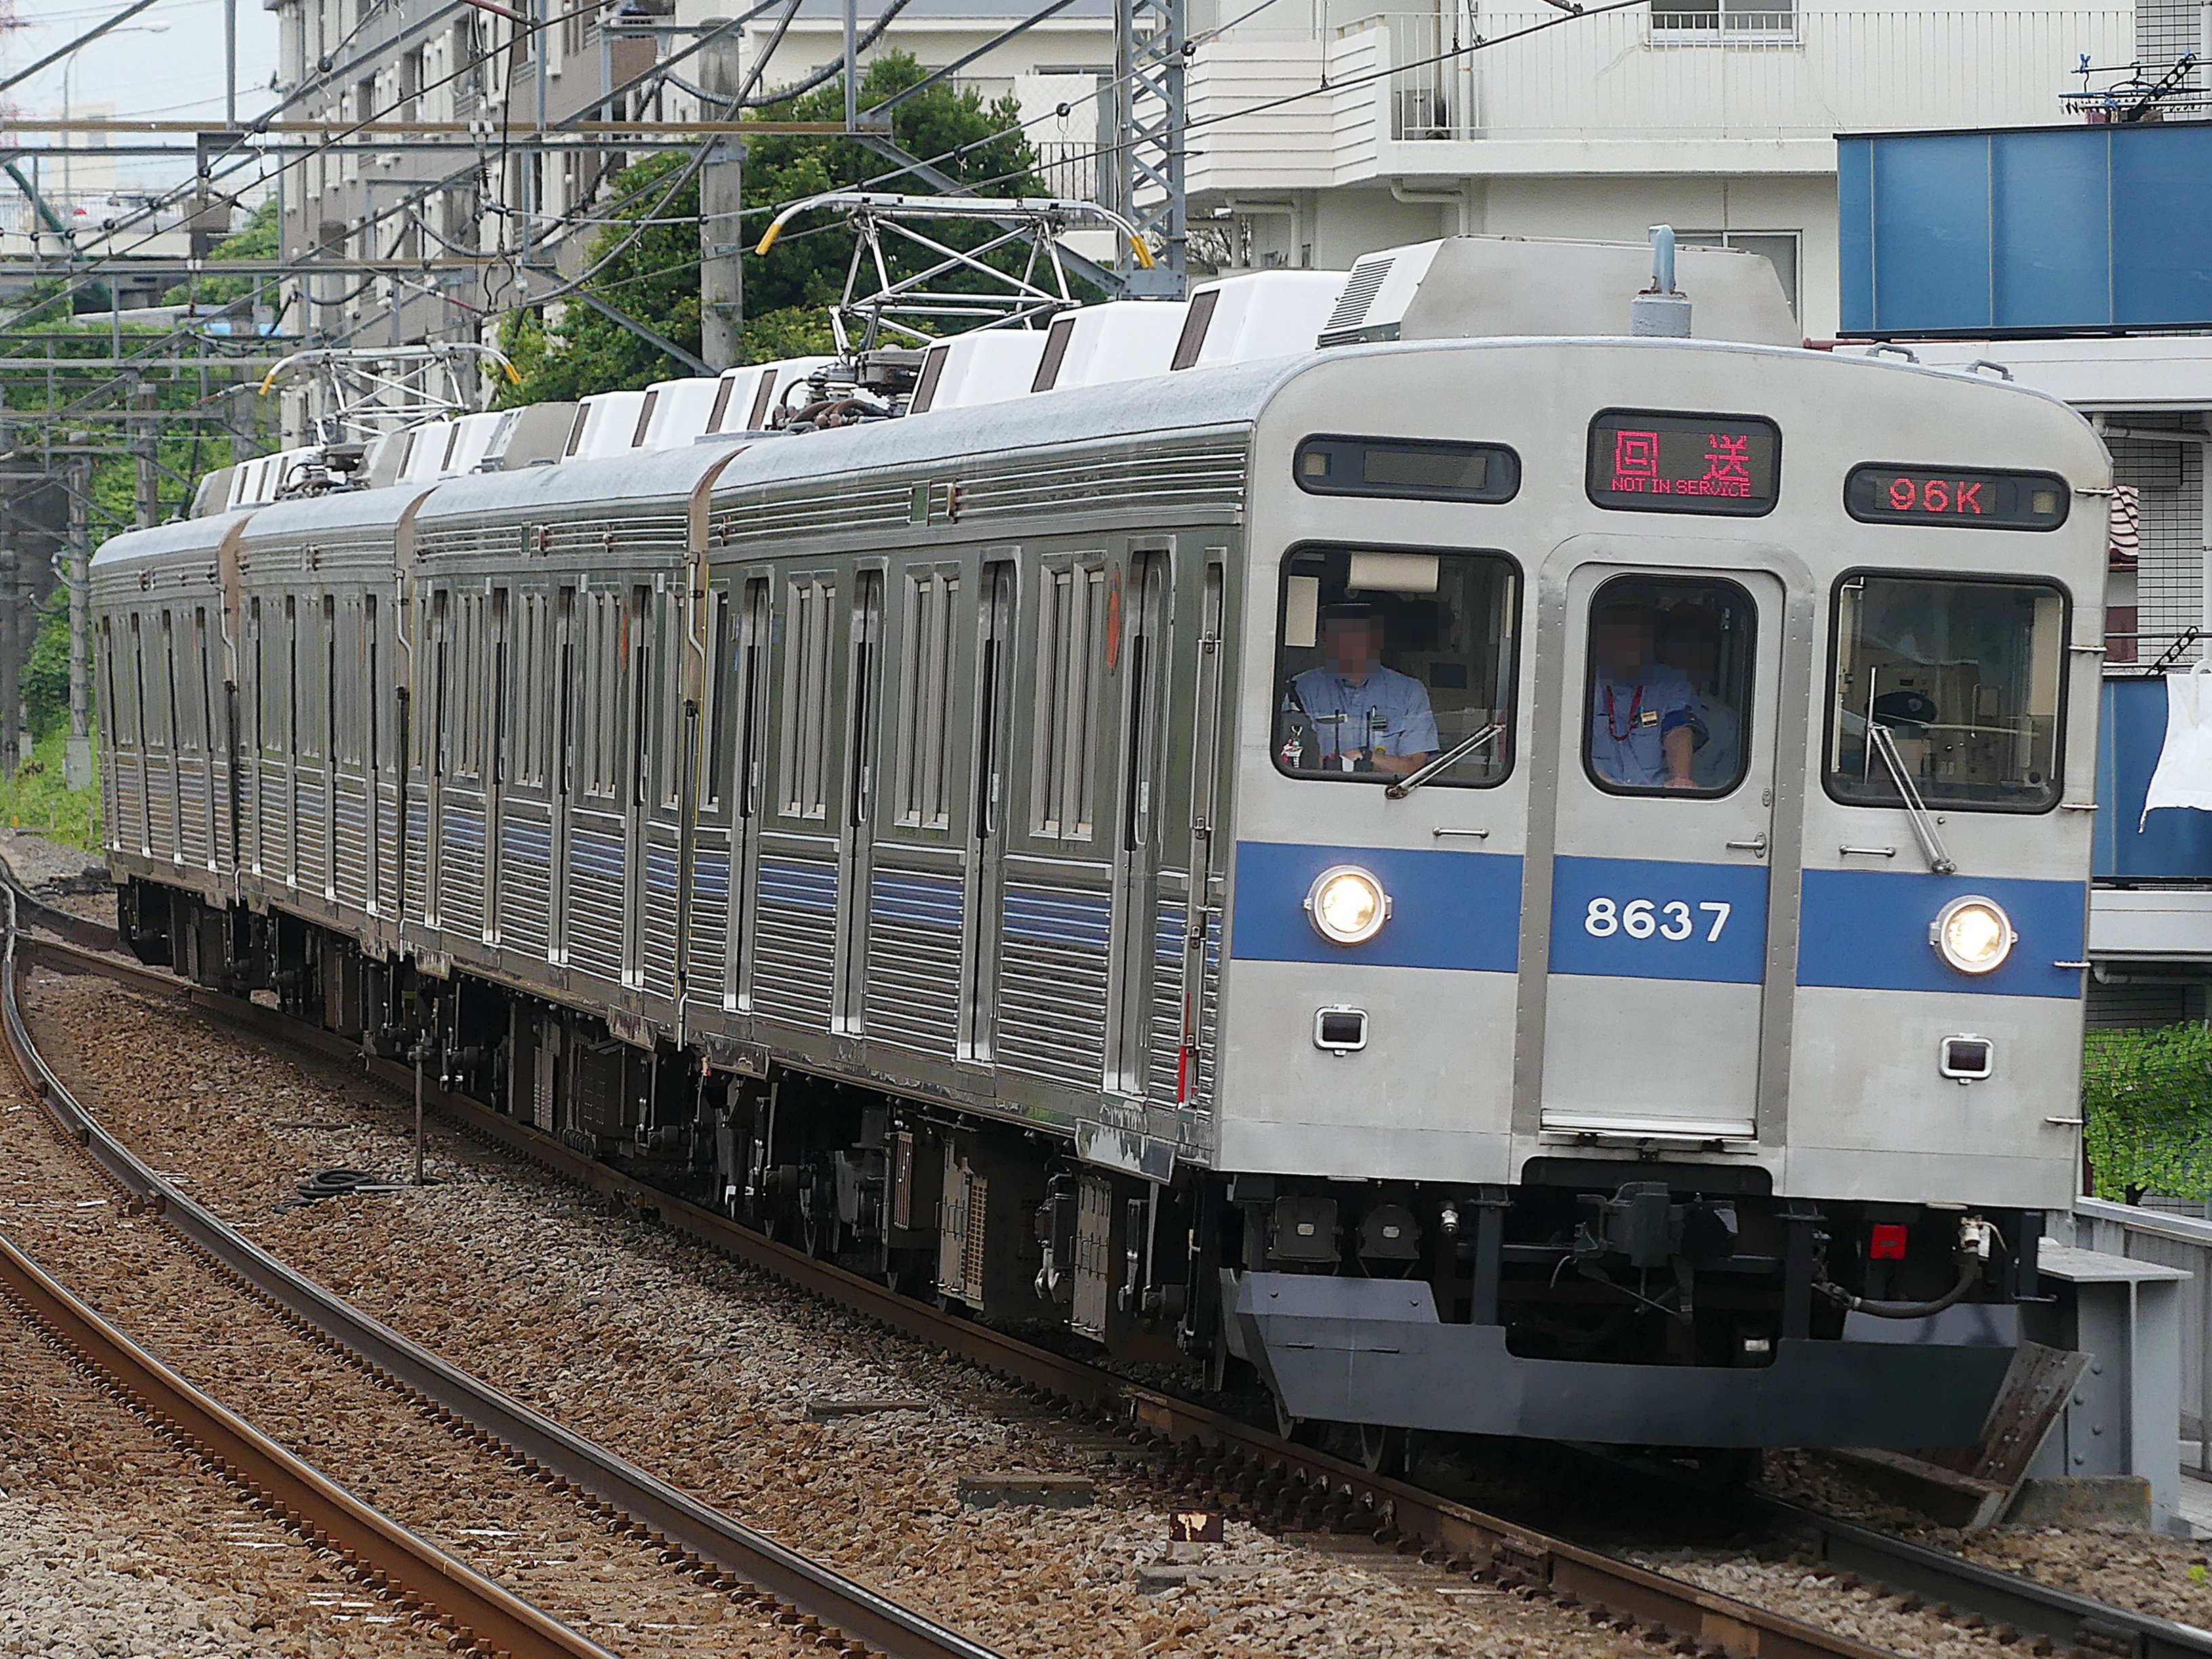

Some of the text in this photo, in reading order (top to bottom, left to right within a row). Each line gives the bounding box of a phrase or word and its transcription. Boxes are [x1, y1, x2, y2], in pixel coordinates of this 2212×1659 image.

[1612, 478, 1752, 497] NOT IN SERVICE
[1889, 478, 1982, 514] 96K
[1584, 897, 1732, 942] 8637
